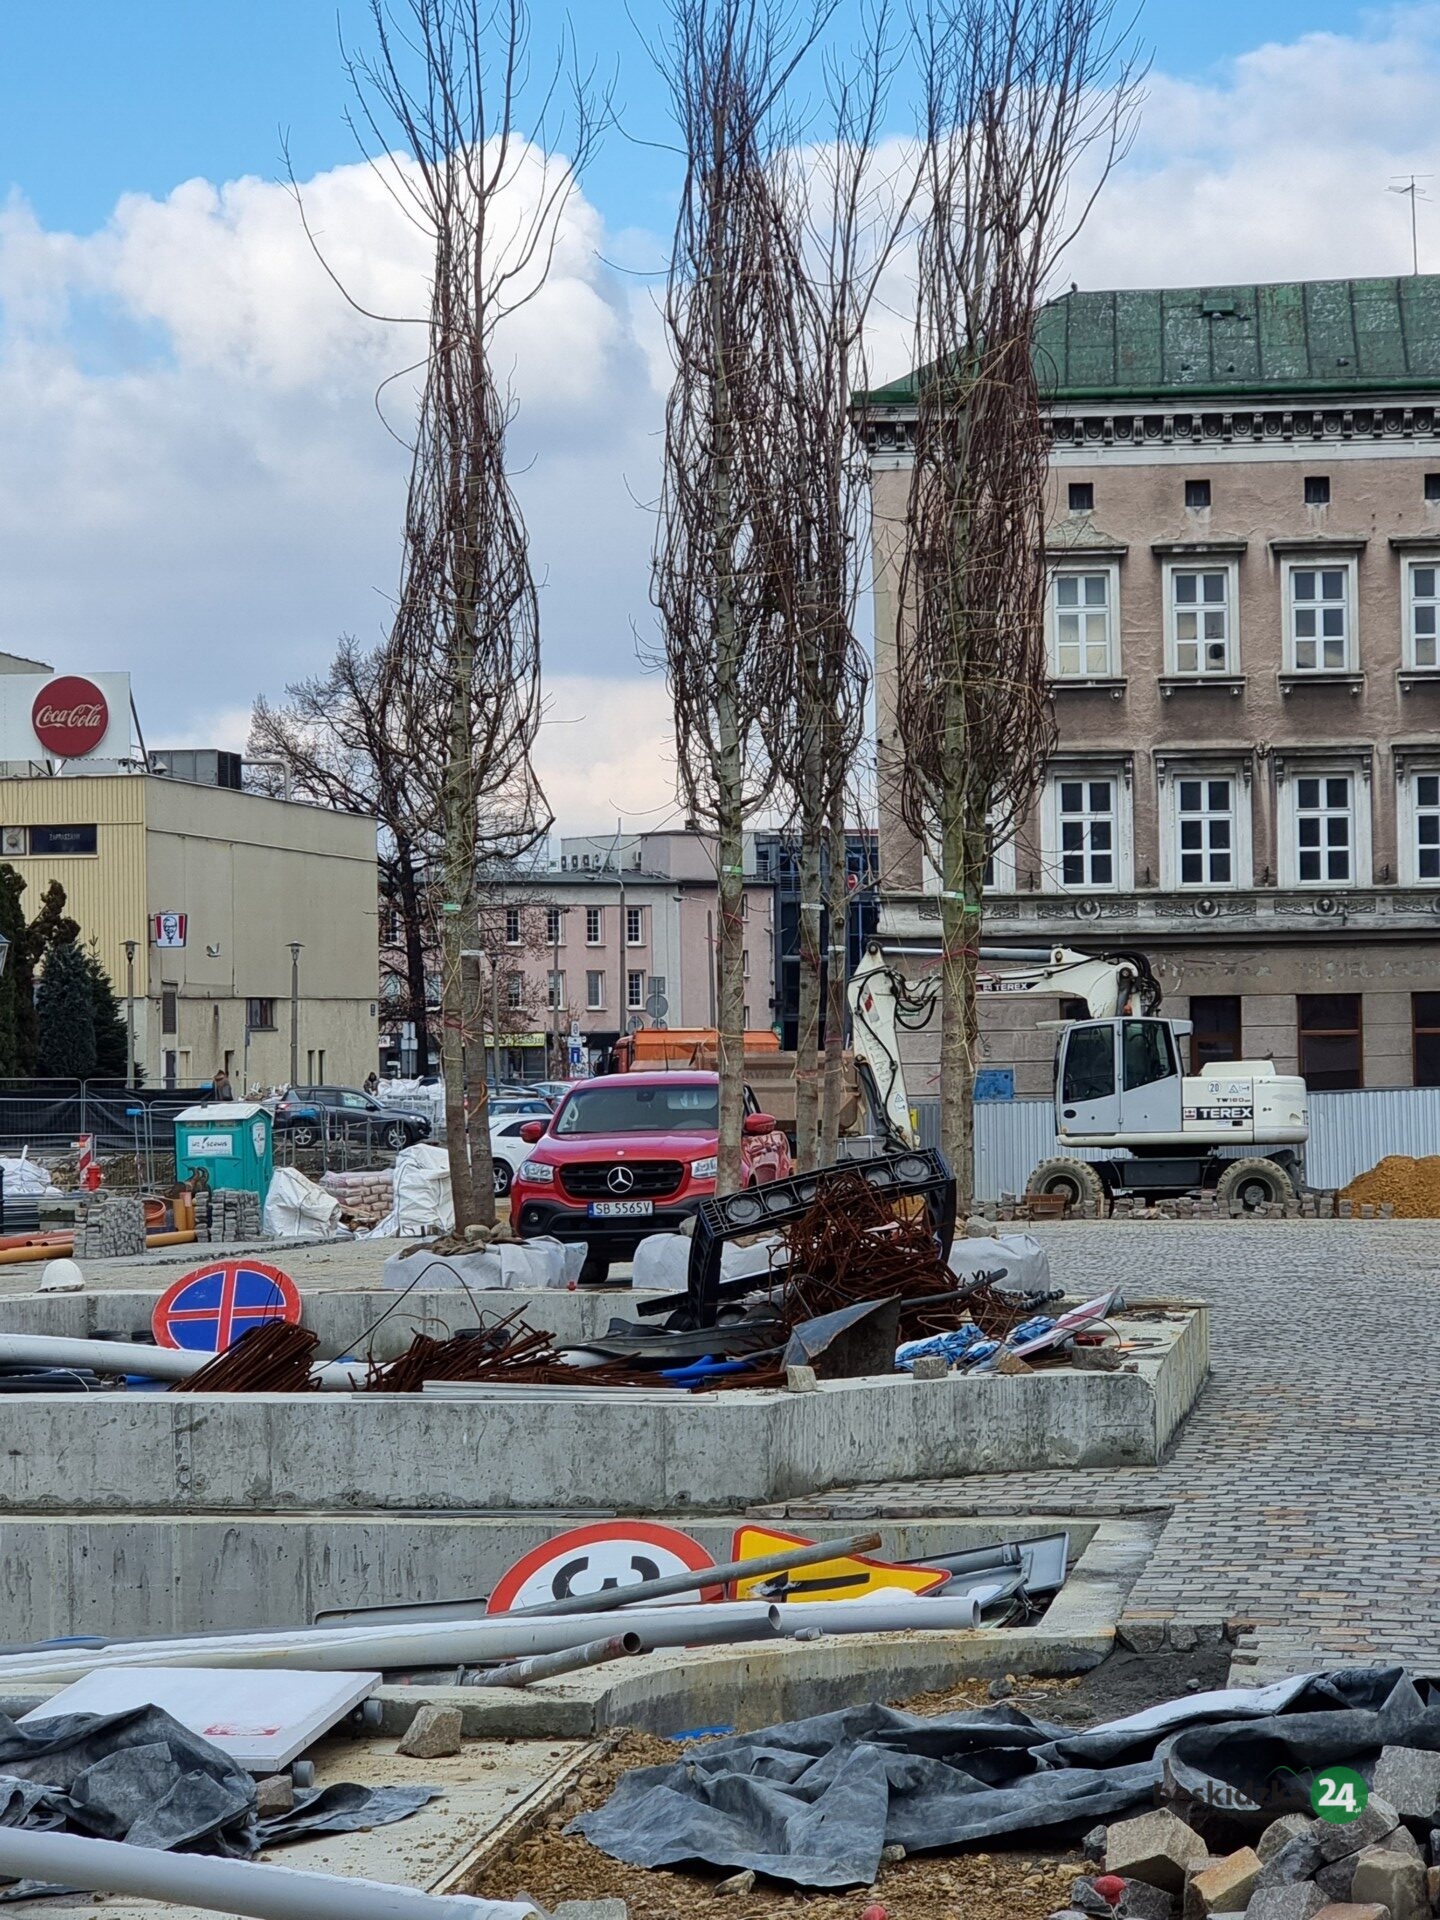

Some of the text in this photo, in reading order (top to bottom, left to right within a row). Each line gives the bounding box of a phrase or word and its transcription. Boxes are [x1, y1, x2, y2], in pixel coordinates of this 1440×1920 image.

[35, 703, 105, 729] Coca-Cola
[994, 983, 1028, 991] TEREX
[1209, 1083, 1220, 1093] 20
[1200, 1108, 1252, 1118] TEREX
[595, 1202, 650, 1214] SB 5565V
